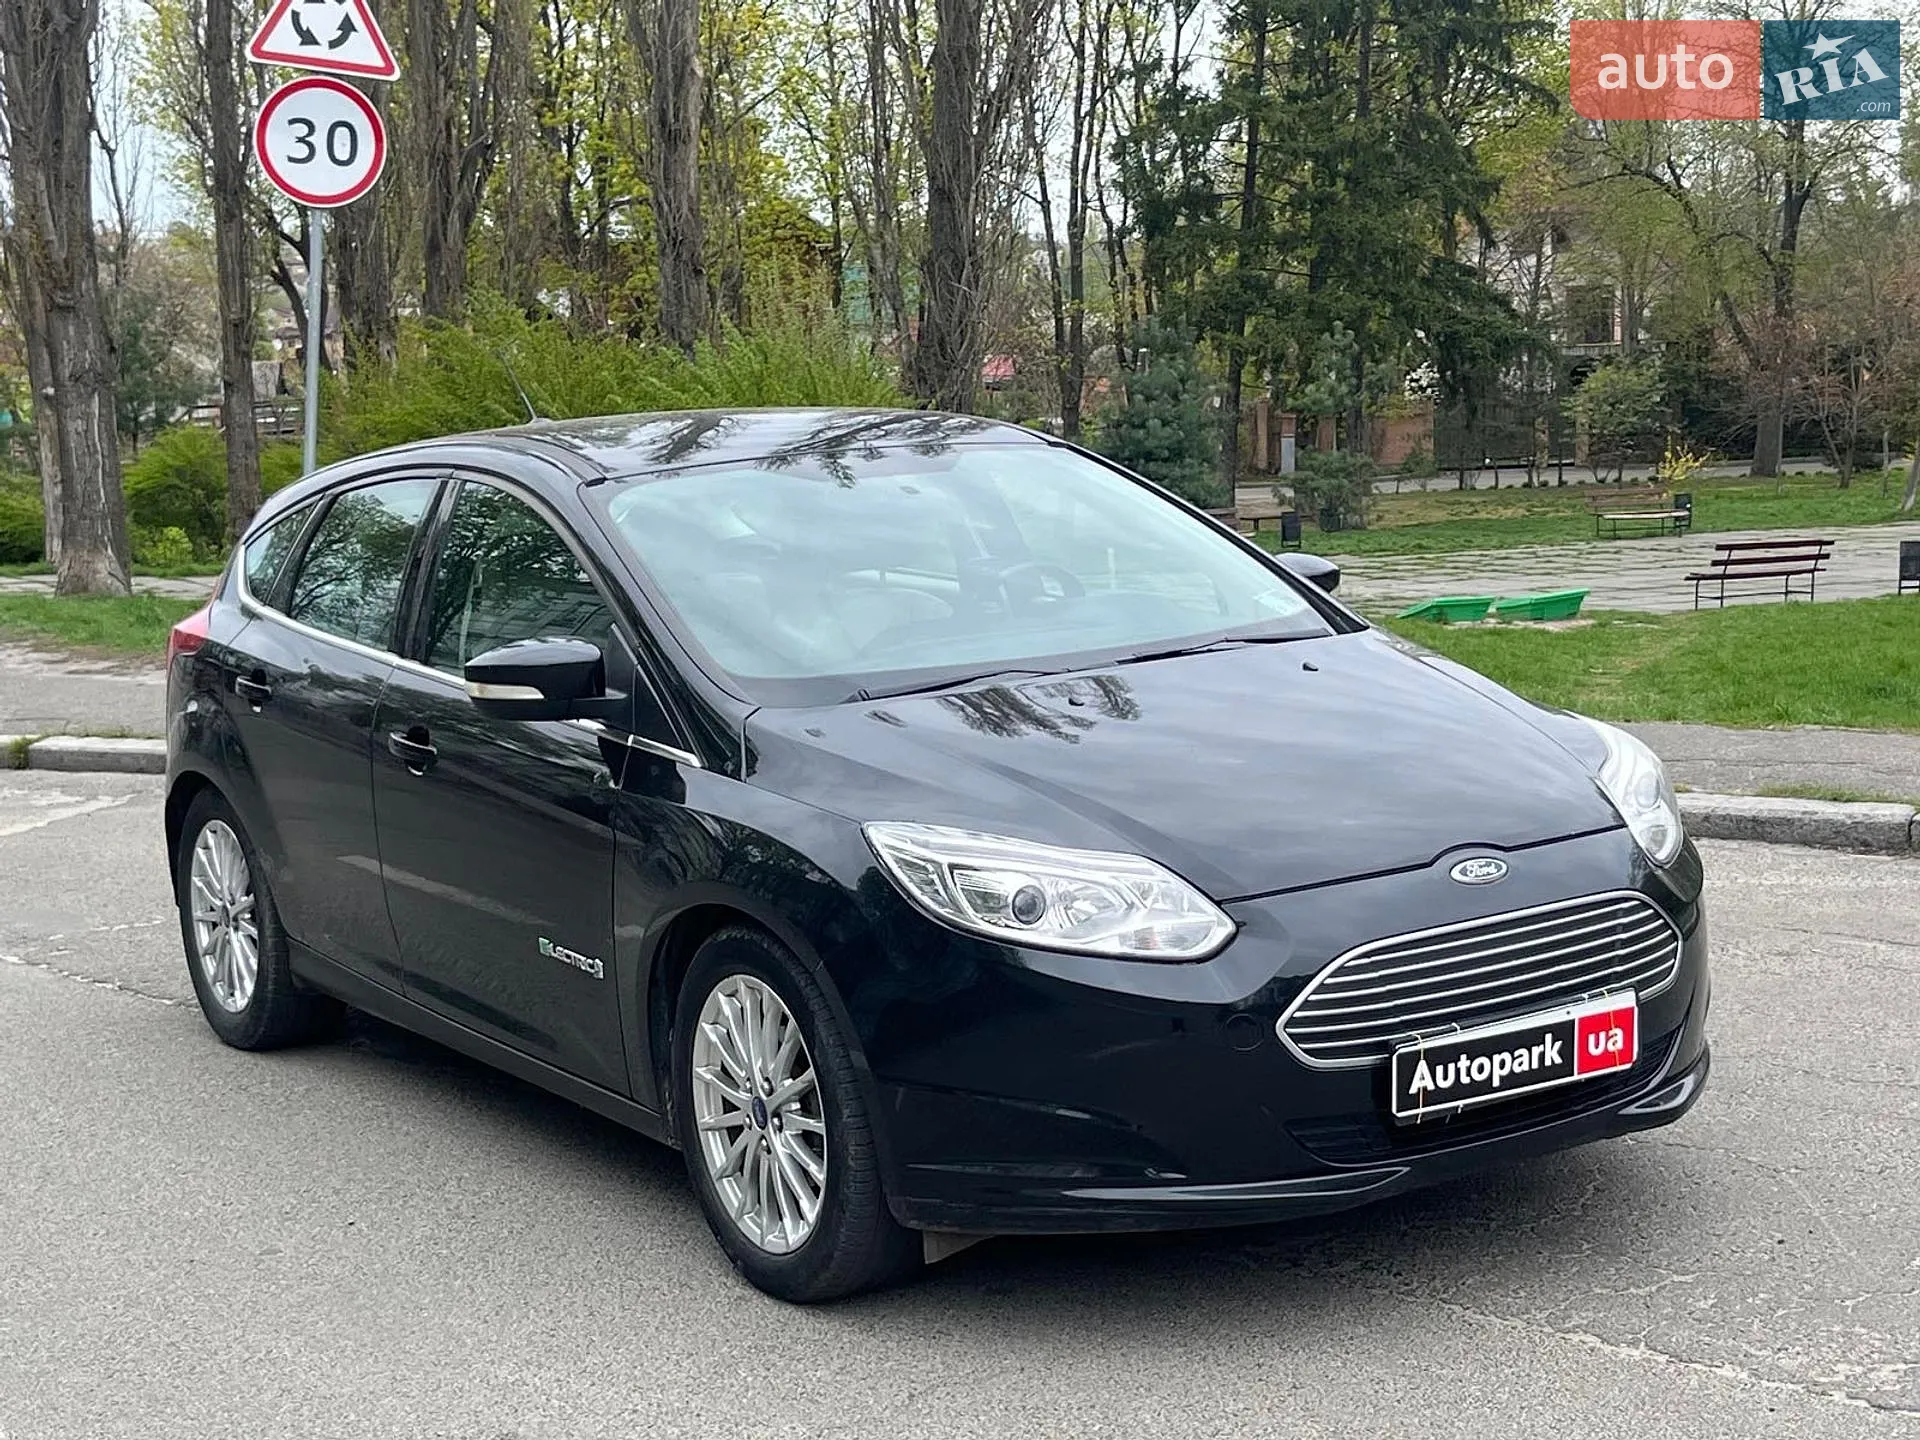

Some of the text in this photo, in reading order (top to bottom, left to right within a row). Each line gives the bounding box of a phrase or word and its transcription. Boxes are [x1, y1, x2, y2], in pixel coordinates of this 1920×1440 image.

[287, 117, 358, 167] 30
[1466, 860, 1498, 877] Ford
[1409, 1026, 1624, 1094] Autopark ua
